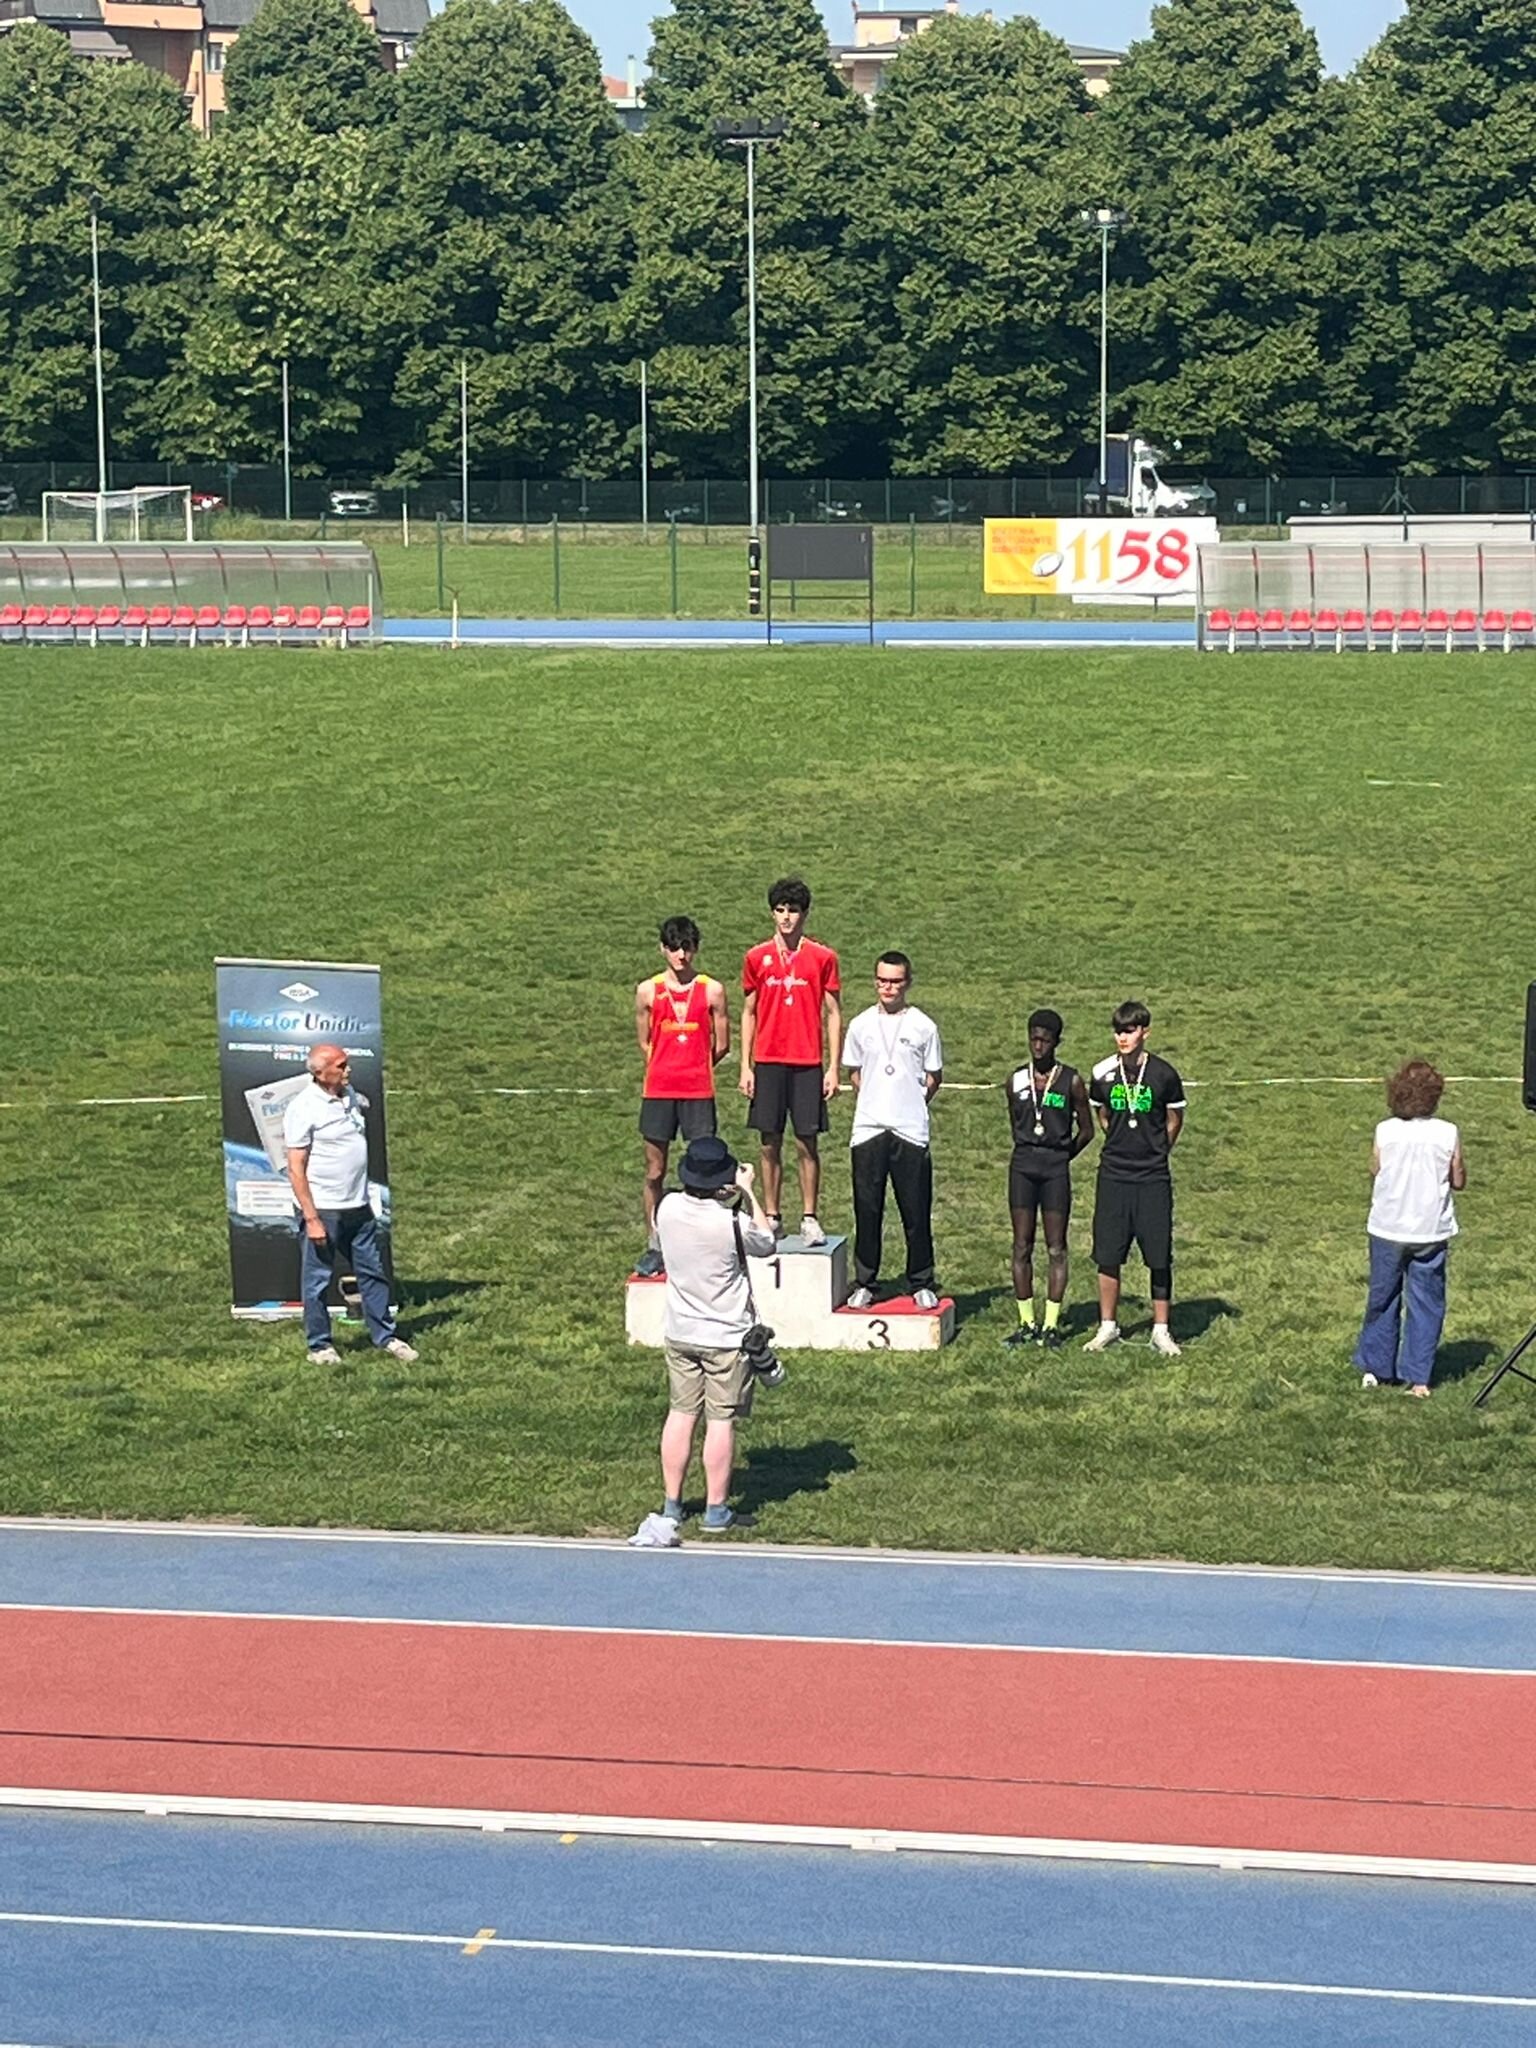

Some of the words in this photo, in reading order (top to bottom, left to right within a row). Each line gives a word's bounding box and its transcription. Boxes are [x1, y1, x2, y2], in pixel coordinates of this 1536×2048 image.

[1066, 528, 1191, 584] 1158
[767, 1257, 782, 1289] 1
[867, 1318, 891, 1350] 3
